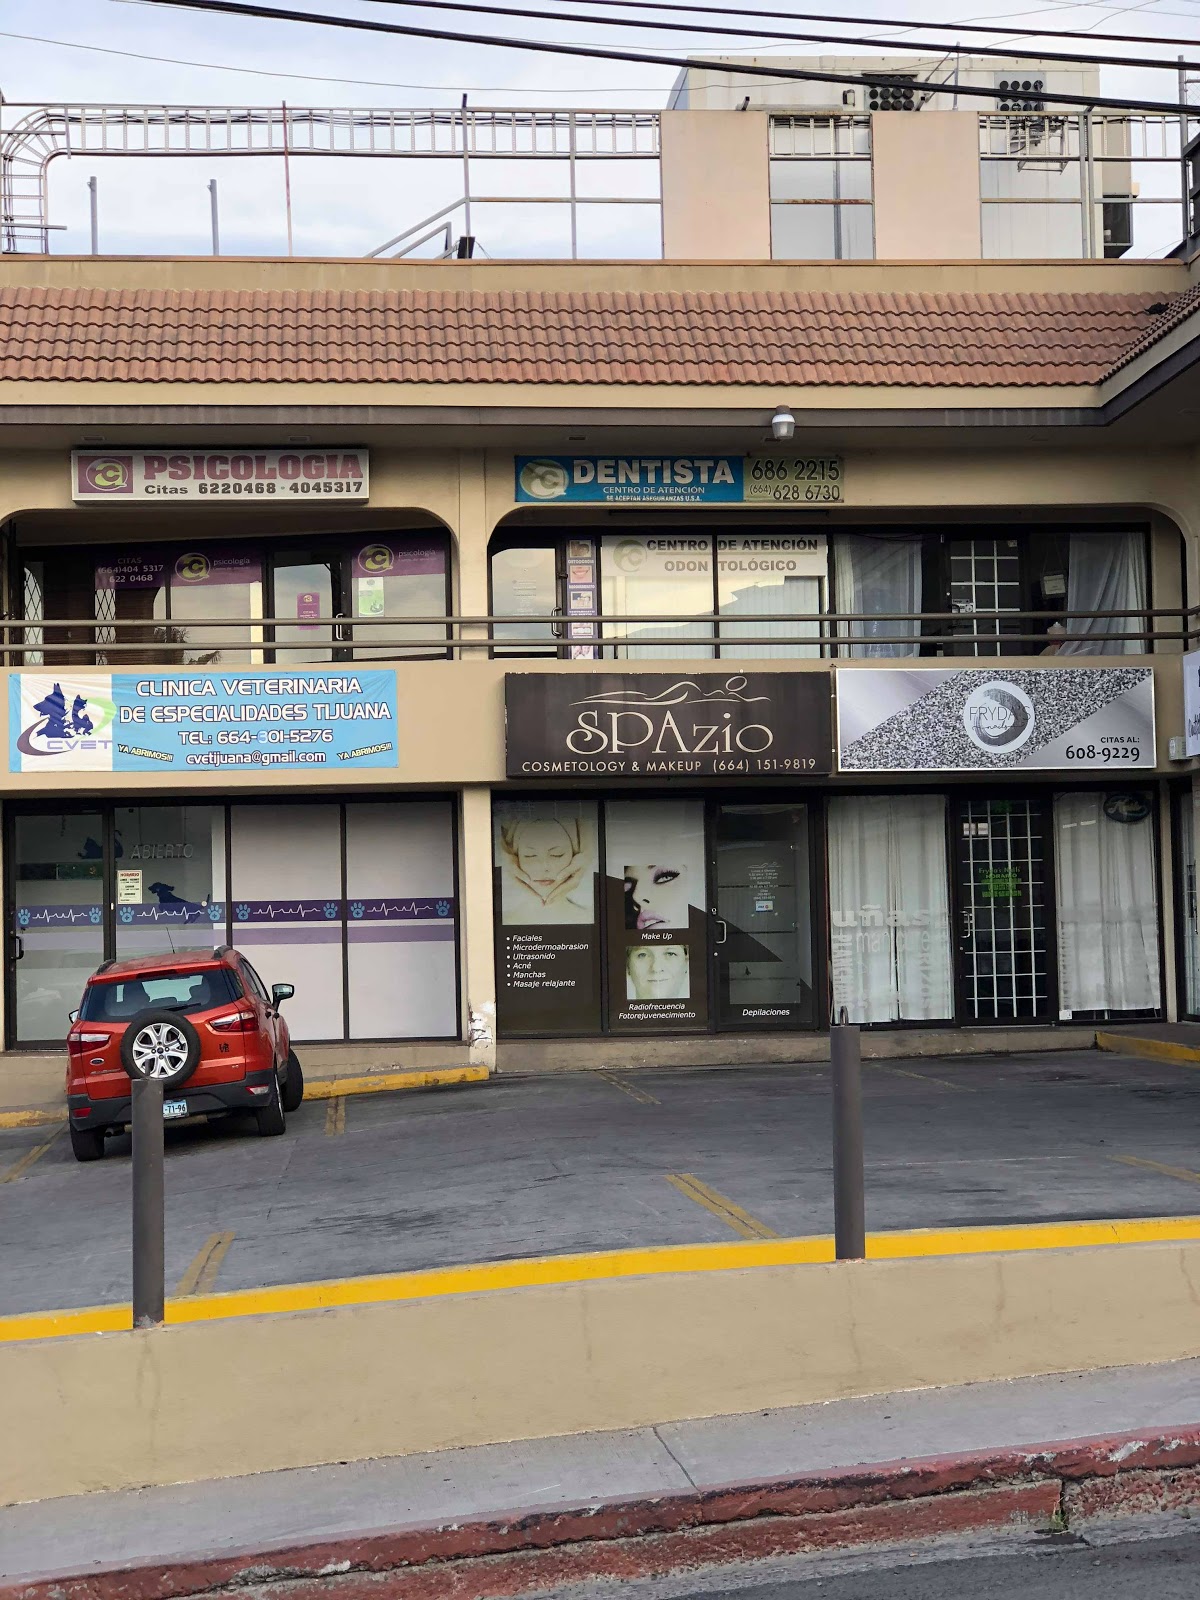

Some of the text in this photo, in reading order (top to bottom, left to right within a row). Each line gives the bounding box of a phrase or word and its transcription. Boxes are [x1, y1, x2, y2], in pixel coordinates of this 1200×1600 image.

[144, 454, 363, 480] PSICOLOGIA
[573, 459, 735, 484] DENTISTA
[752, 460, 840, 480] 686 2215
[144, 481, 363, 494] Citas 6220468 4045317
[657, 485, 705, 494] ATENCIÓN
[750, 484, 840, 500] (664) 628 6730
[646, 537, 818, 551] CENTRO DE ATENCIÓN
[213, 557, 251, 567] psicología
[110, 575, 126, 583] 622
[136, 677, 362, 696] CLINICA VETERINARIA
[119, 702, 392, 723] DE ESPECIALIDADES TIJUANA
[178, 729, 333, 744] TEL: 664-301-5276
[566, 709, 774, 755] SPAzio
[46, 740, 113, 750] CVET
[1101, 736, 1125, 744] CITAS
[118, 744, 131, 755] YA
[337, 750, 350, 760] YA
[1066, 744, 1141, 762] 608-9229
[186, 750, 326, 767] cvetijuana@gmail.com
[522, 758, 816, 772] COSMETOLOGY & MAKEUP (664) 151-9819
[131, 844, 193, 859] ABIERTO
[512, 934, 543, 942] Faciales
[662, 933, 673, 941] Up
[512, 980, 576, 989] Masaje relajante
[628, 1003, 686, 1011] Radiofrecuencia
[742, 1008, 790, 1017] Depilaciones
[618, 1012, 696, 1020] Fotorejuvenecimiento
[164, 1104, 186, 1114] -71-96
